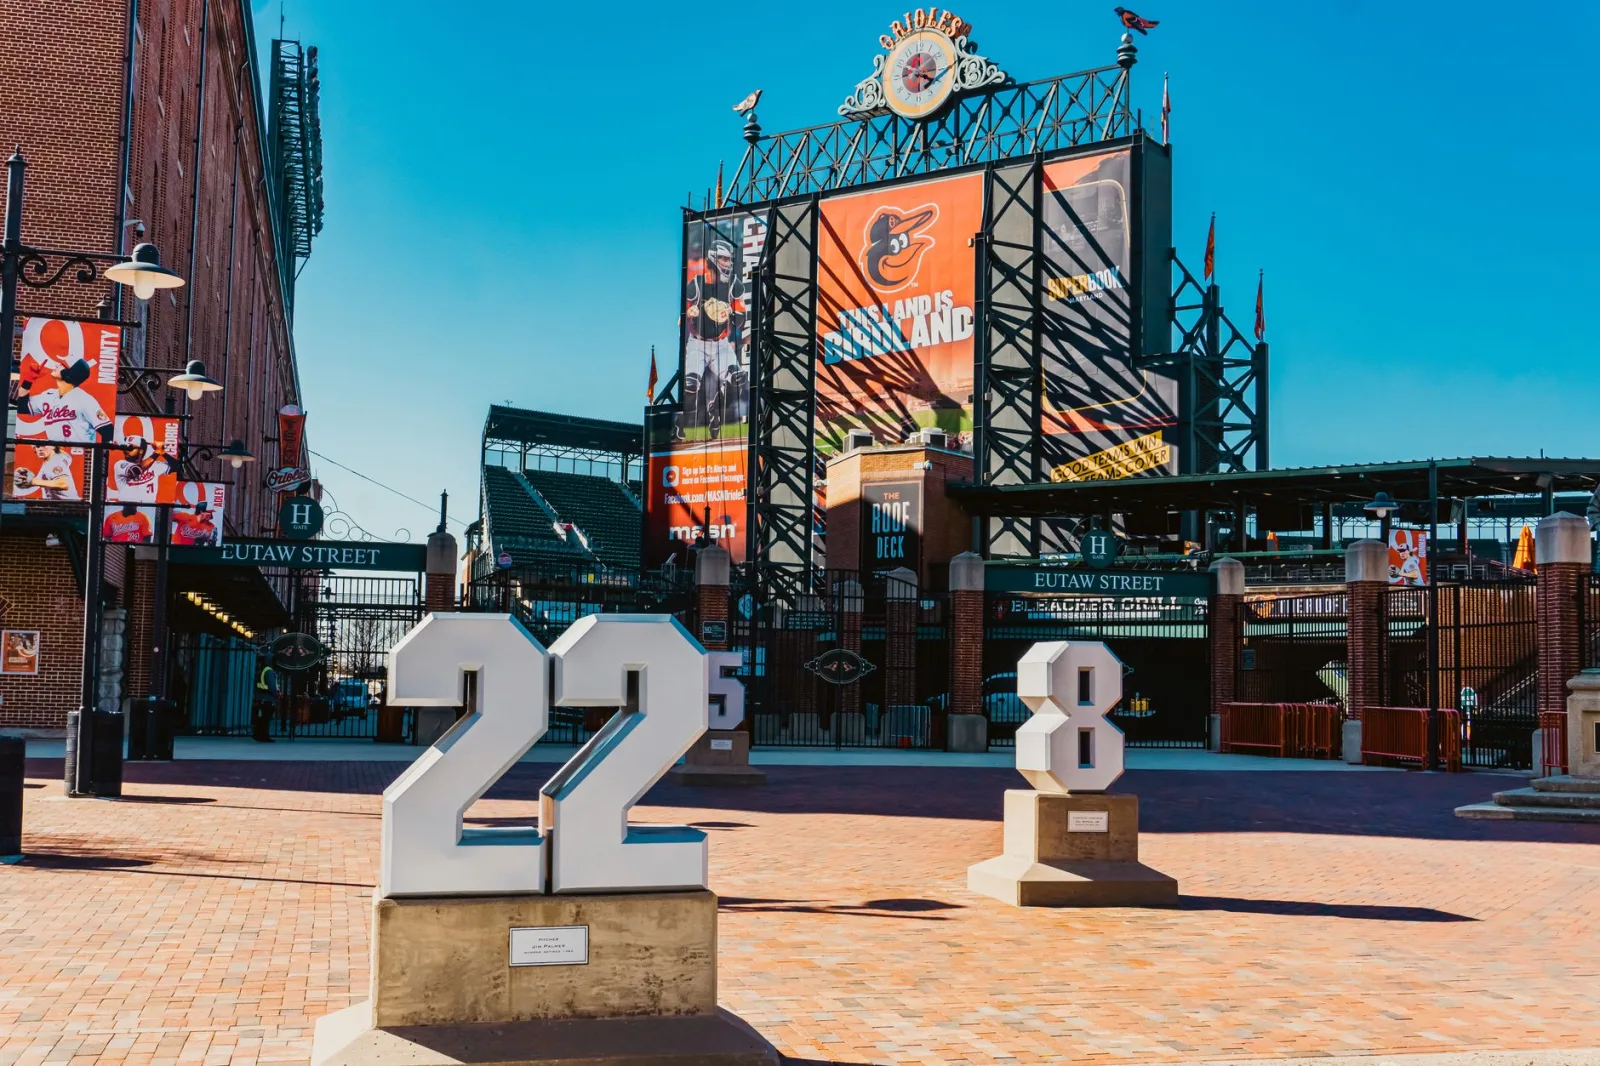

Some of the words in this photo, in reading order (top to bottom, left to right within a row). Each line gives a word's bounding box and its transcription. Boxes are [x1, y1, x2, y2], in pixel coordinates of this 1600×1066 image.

[879, 7, 962, 50] ORIOLES
[1047, 265, 1122, 301] SUPERBOOK
[836, 306, 880, 330] THIS
[882, 294, 932, 322] LAND
[934, 289, 954, 312] IS
[1069, 292, 1103, 303] MARYLAND
[824, 306, 974, 365] BIRDLAND
[97, 330, 120, 385] MOUNTY
[42, 402, 77, 428] Orioles
[62, 425, 72, 438] 6
[165, 422, 179, 456] CEDRIC
[283, 418, 297, 464] TEAM
[1053, 460, 1090, 481] GOOD
[1093, 444, 1130, 467] TEAMS
[1126, 449, 1167, 473] COVER
[267, 468, 311, 493] Orioles
[213, 486, 225, 508] ADLEY
[883, 492, 900, 500] THE
[291, 503, 312, 525] H
[872, 501, 910, 534] ROOF
[669, 523, 736, 541] masn
[221, 543, 296, 562] EUTAW
[301, 546, 380, 565] STREET
[877, 536, 905, 559] DECK
[1089, 536, 1107, 555] H
[1034, 572, 1095, 589] EUTAW
[1100, 575, 1164, 591] STREET
[1011, 598, 1116, 612] BLEACHER
[1121, 597, 1182, 610] GRILL
[707, 652, 746, 731] 5
[1015, 640, 1125, 794] 8
[373, 611, 709, 898] 22
